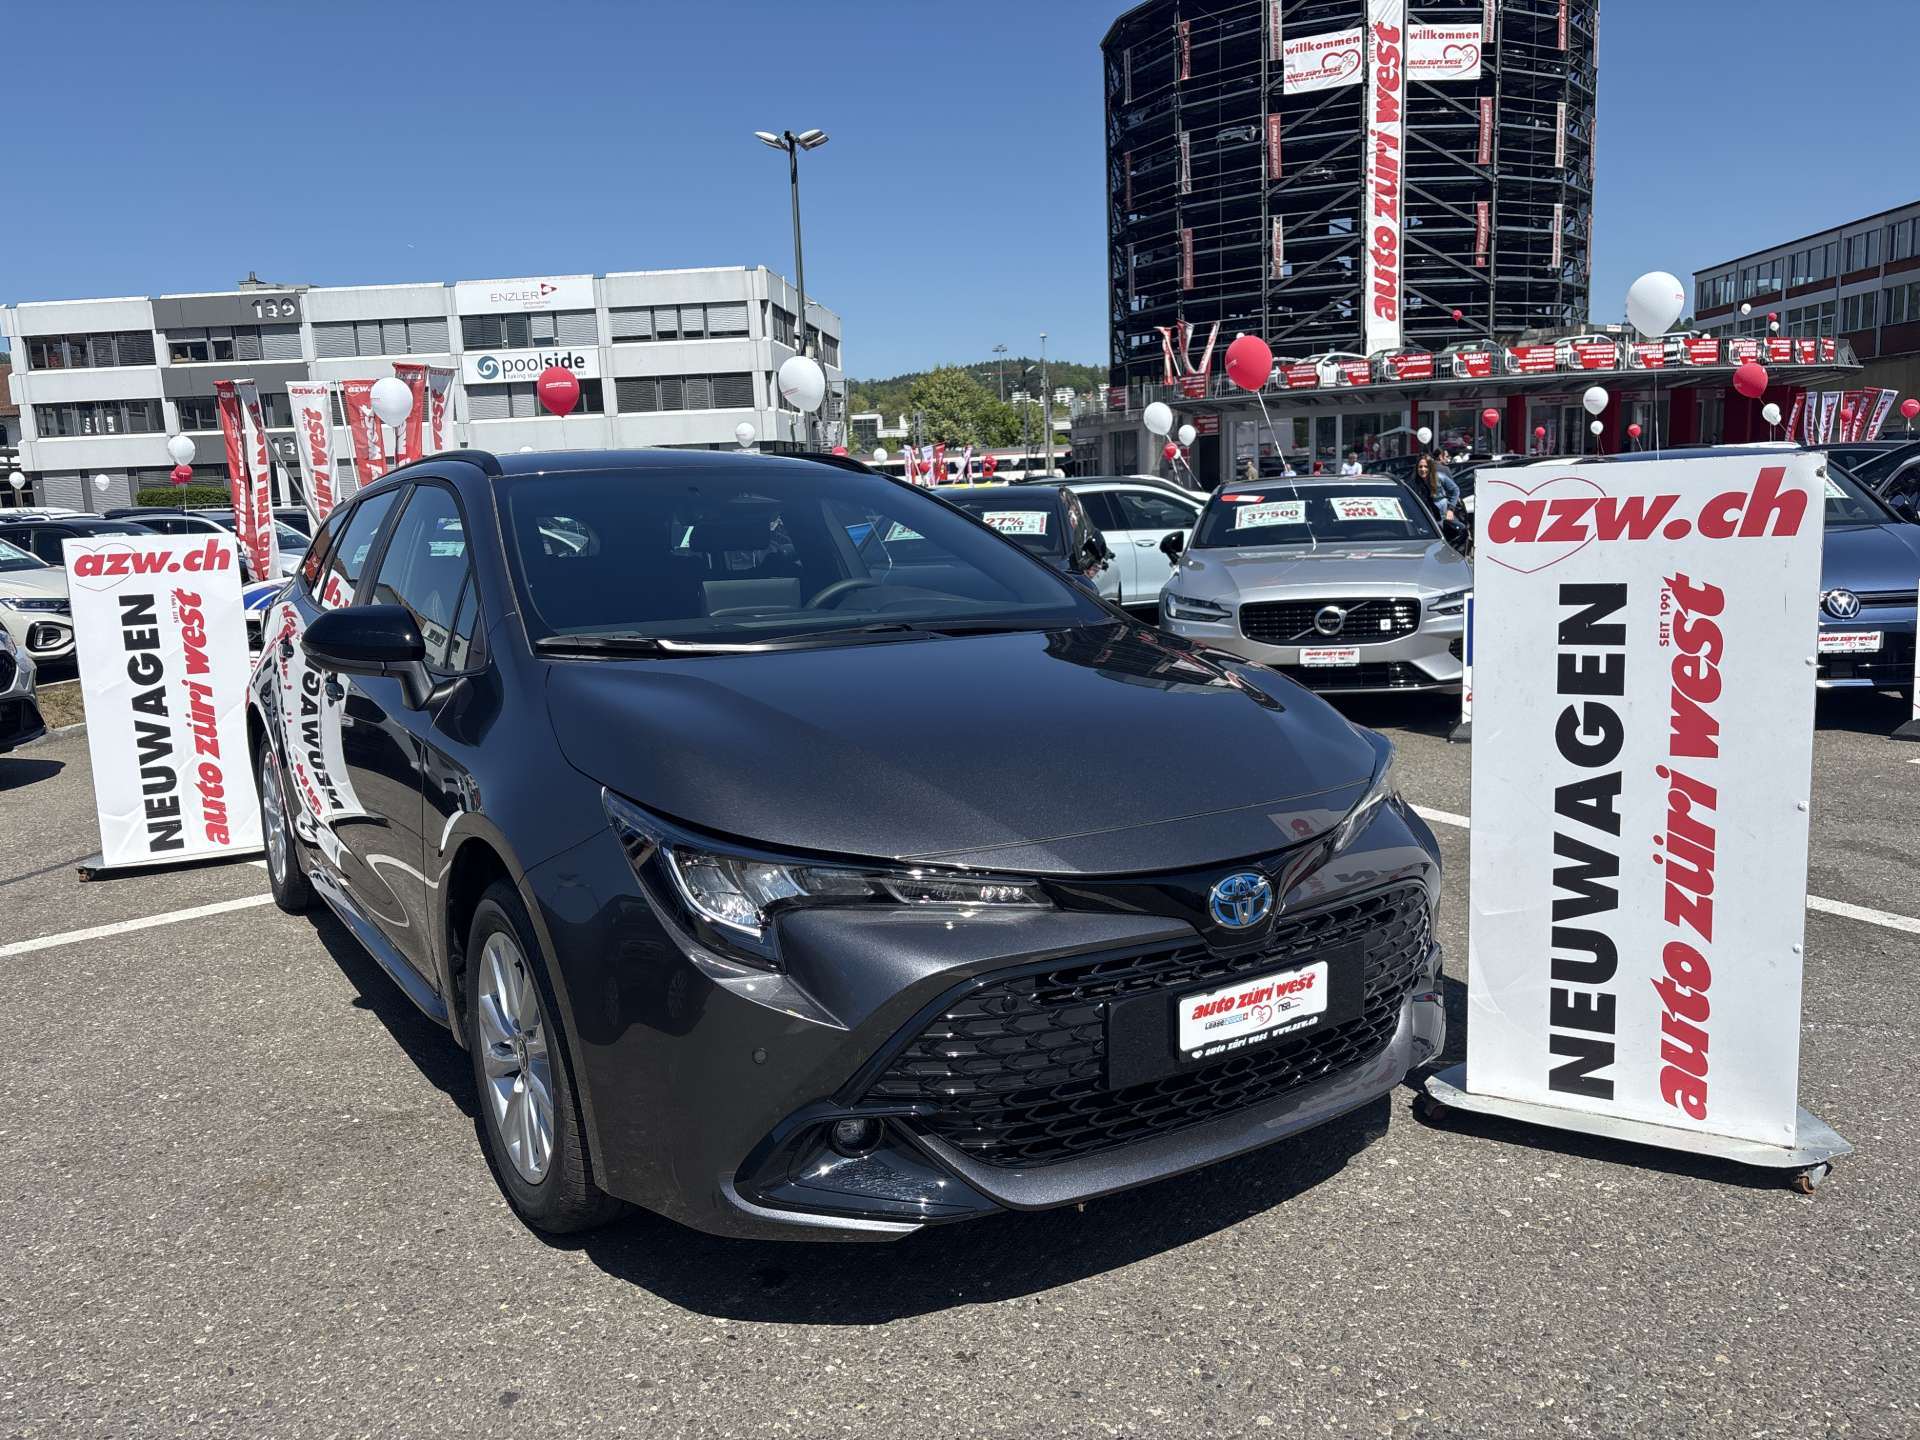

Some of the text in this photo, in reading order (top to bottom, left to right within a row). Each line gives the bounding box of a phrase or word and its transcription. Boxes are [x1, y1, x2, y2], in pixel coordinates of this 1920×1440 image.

[1285, 34, 1361, 55] willkommen
[1409, 29, 1480, 40] willkommen
[1368, 20, 1401, 323] auto züri west
[251, 298, 296, 318] 139
[490, 291, 540, 303] ENZLER
[502, 351, 585, 379] poolside
[347, 386, 372, 394] azw.
[304, 407, 329, 466] west
[986, 517, 1025, 528] 27%
[1247, 510, 1299, 520] 37'500
[1487, 466, 1808, 544] azw.ch
[74, 539, 231, 577] azw.ch
[1659, 587, 1671, 647] SEIT 1991
[118, 593, 185, 853] NEUWAGEN
[170, 587, 230, 845] auto züri west
[1548, 583, 1628, 1101] NEUWAGEN
[1650, 571, 1725, 1121] auto züri west
[1192, 973, 1316, 1020] auto züri west
[1205, 1016, 1319, 1056] auto züri west www.azw.ch
